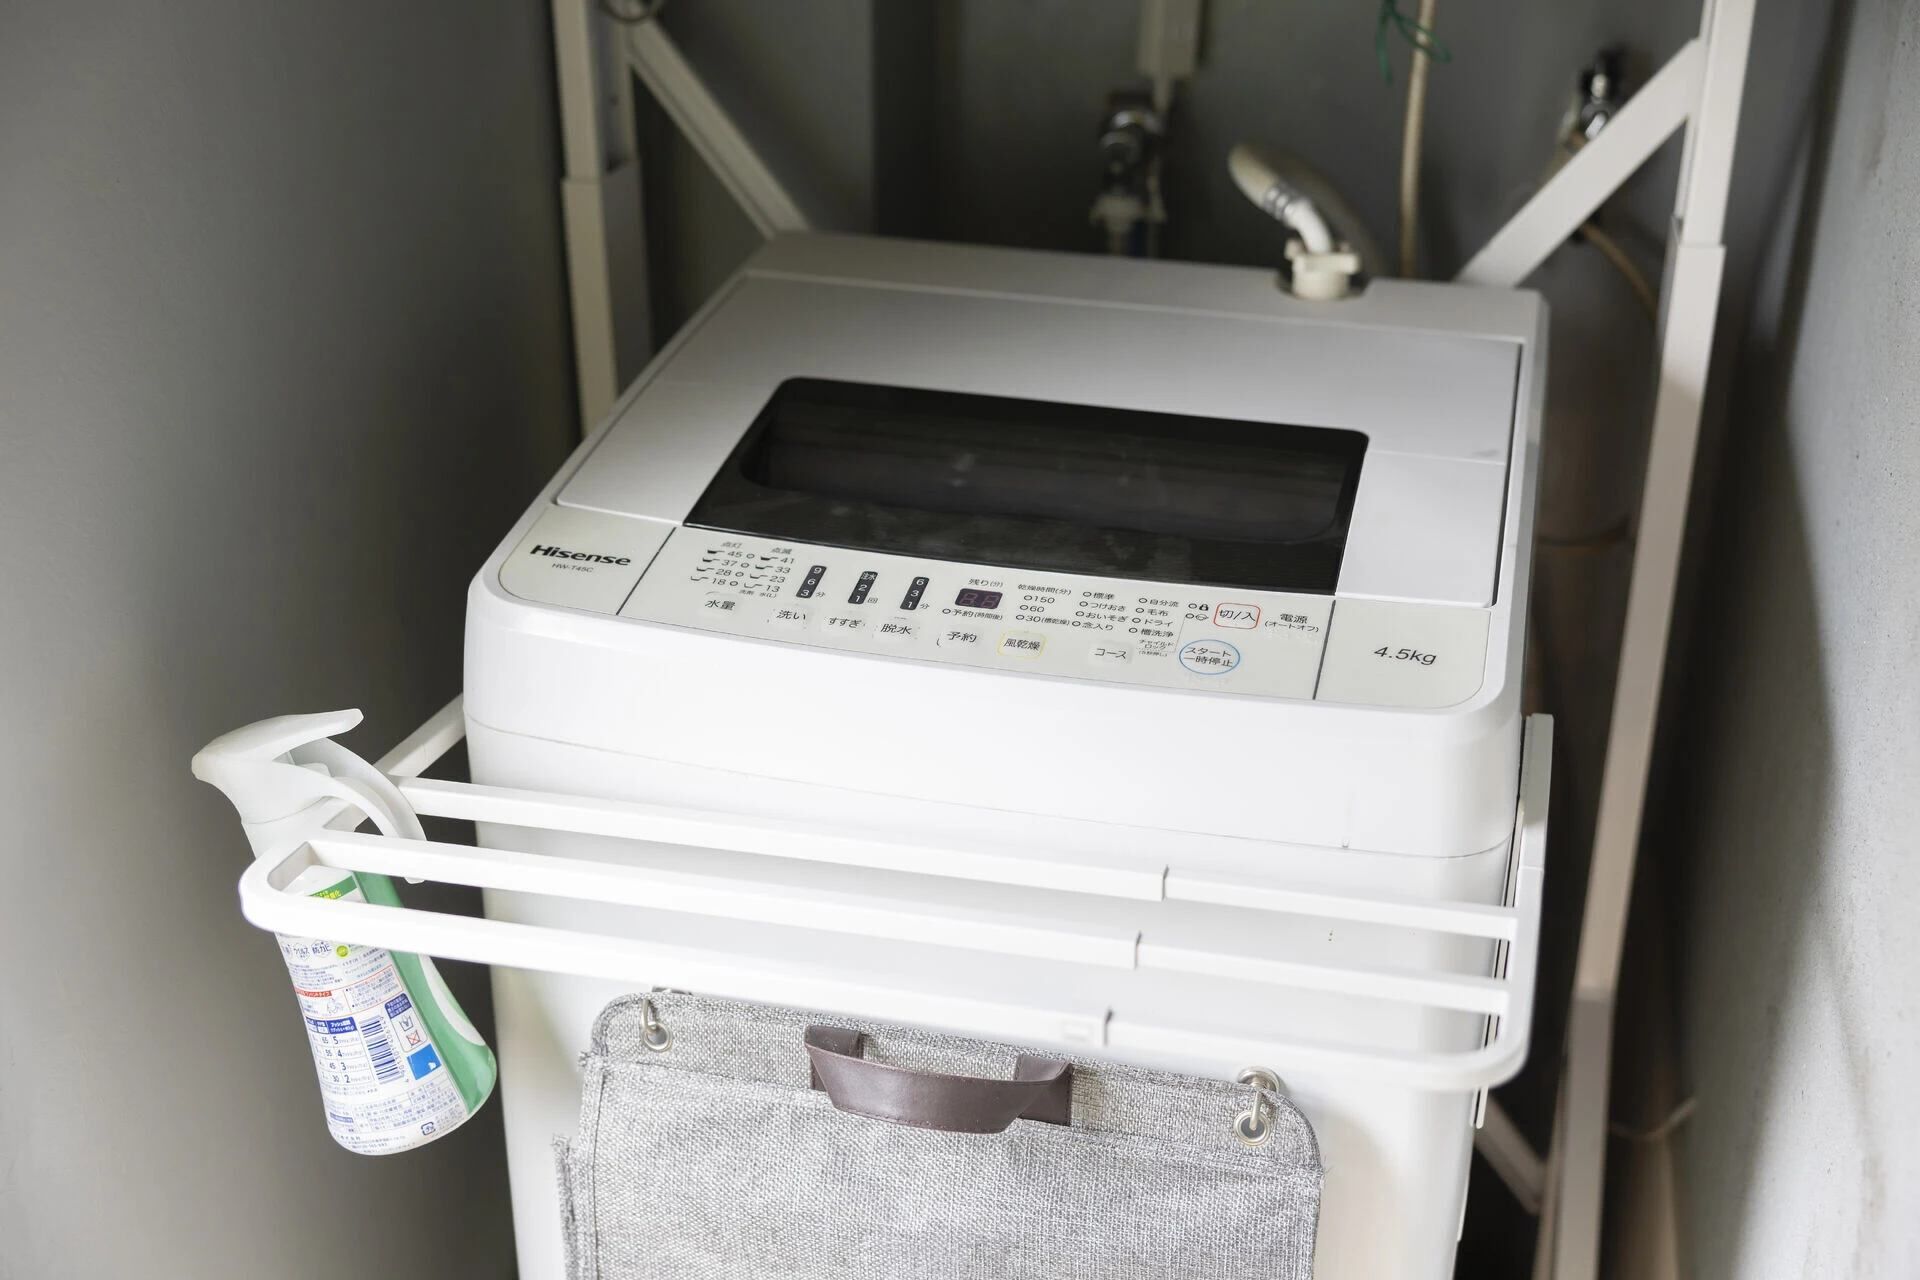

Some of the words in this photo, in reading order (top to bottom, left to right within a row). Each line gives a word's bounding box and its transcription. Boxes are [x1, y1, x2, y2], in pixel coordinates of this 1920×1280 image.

[529, 544, 631, 566] Hisense
[727, 550, 743, 558] 45
[780, 556, 795, 564] 41
[551, 562, 594, 573] HW-T45C
[721, 559, 738, 567] 37
[774, 566, 791, 574] 33
[715, 568, 732, 576] 28
[769, 575, 786, 583] 23
[711, 577, 726, 585] 18
[765, 584, 781, 593] 13
[916, 578, 924, 586] 6
[800, 589, 809, 597] 3
[859, 584, 867, 592] 2
[705, 600, 736, 611] 水量
[1029, 605, 1045, 613] 60
[776, 609, 806, 620] 洗い
[1219, 609, 1256, 622] 切/入
[1280, 613, 1308, 624] 電源
[829, 617, 862, 629] すすぎ
[880, 623, 912, 635] 脱水
[946, 631, 977, 643] 予約
[1003, 638, 1040, 651] 風乾燥
[1094, 648, 1127, 659] コース
[1185, 646, 1232, 657] スタート
[1373, 646, 1437, 666] 4.5kg
[1184, 655, 1233, 668] 一時停止
[332, 1036, 339, 1045] 5
[337, 1049, 343, 1057] 4
[341, 1062, 347, 1071] 3
[344, 1075, 350, 1083] 2
